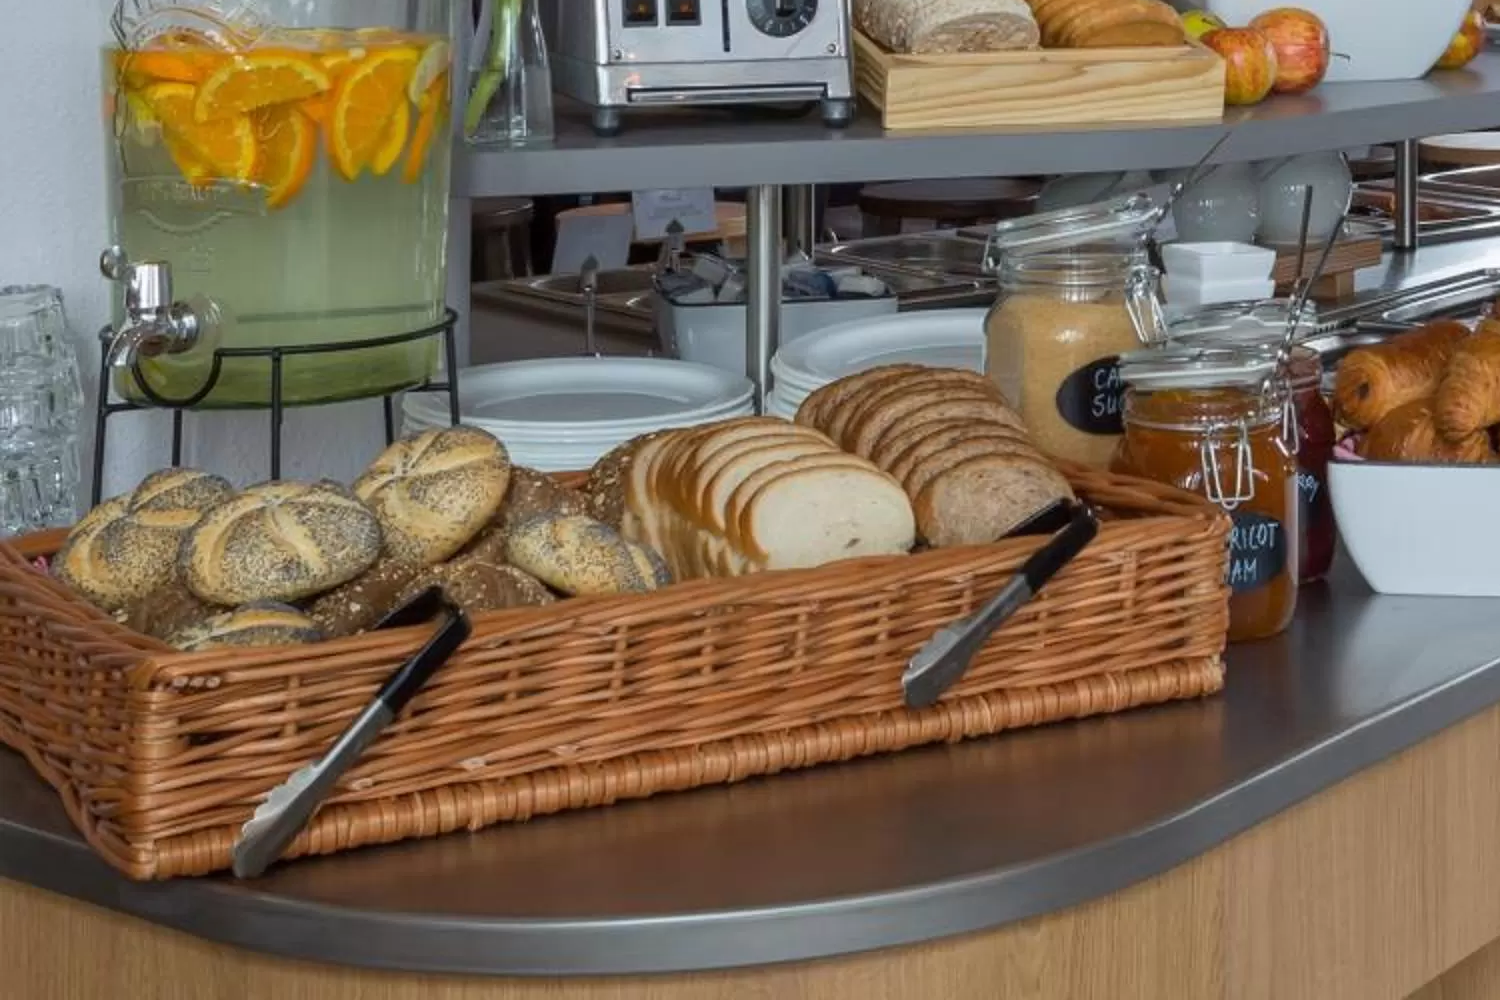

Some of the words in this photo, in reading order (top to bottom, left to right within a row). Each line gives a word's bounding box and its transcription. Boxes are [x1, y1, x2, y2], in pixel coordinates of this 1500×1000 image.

[1094, 367, 1120, 390] CA
[1229, 522, 1280, 550] RICOT
[1230, 557, 1258, 584] AM
